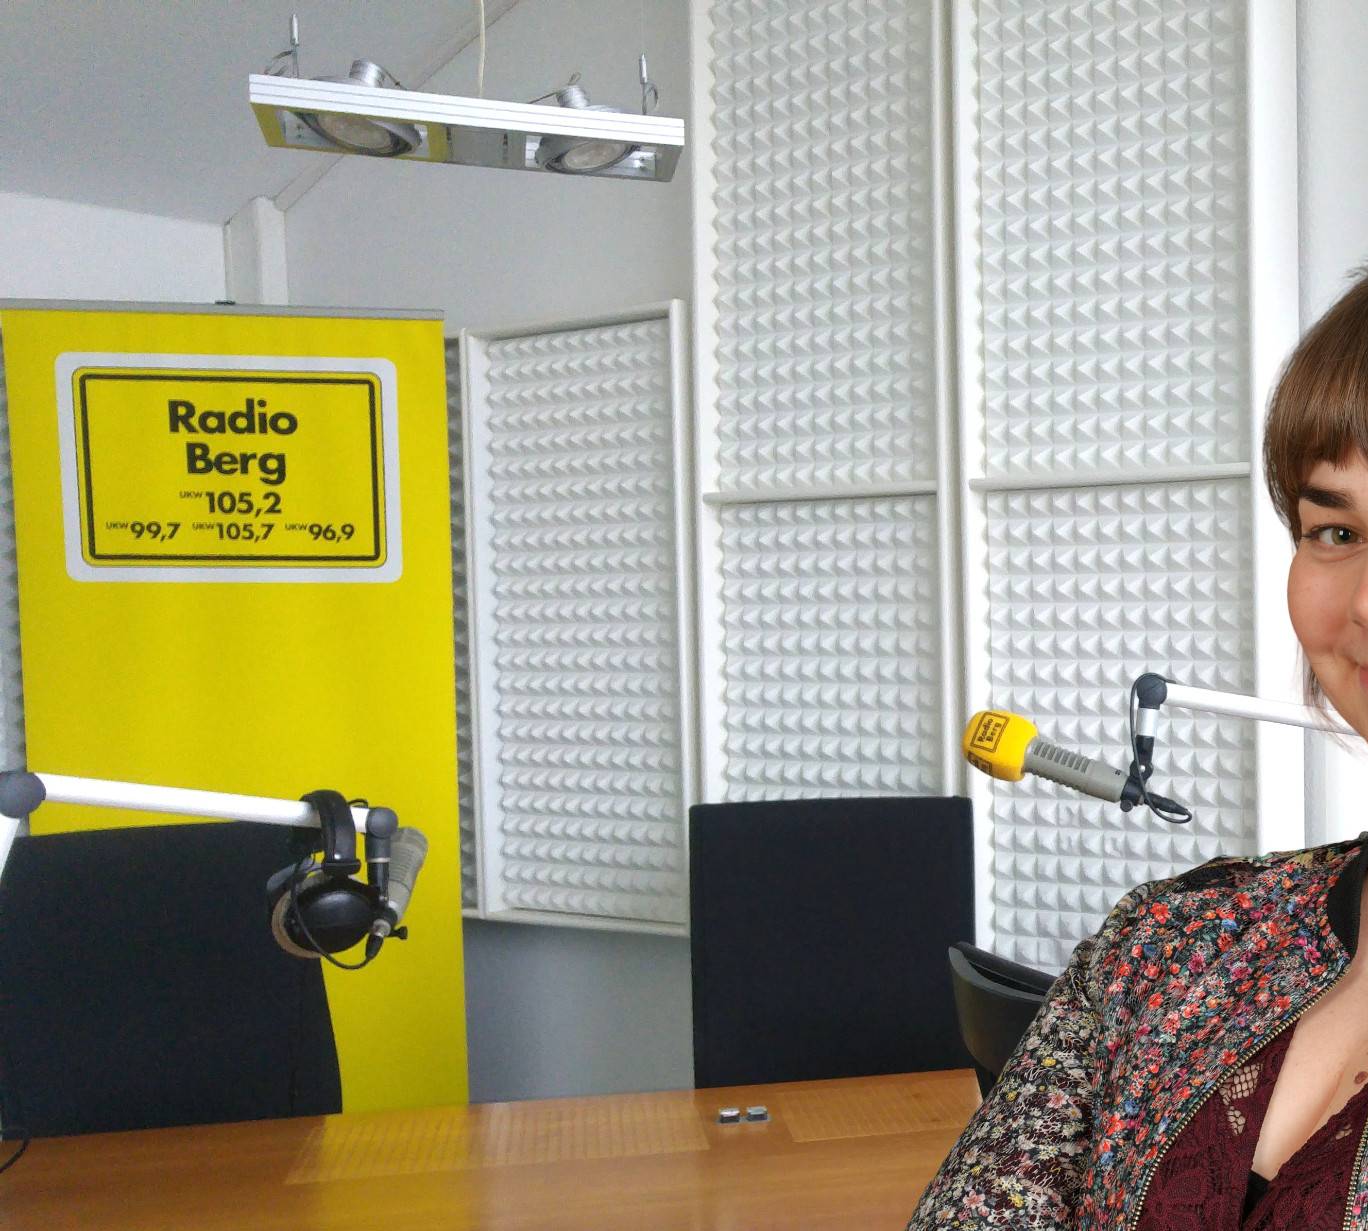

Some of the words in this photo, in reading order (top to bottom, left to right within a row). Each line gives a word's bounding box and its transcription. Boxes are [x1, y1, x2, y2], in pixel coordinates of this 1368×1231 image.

[168, 398, 298, 435] Radio
[186, 441, 286, 486] Berg
[179, 491, 203, 499] UKW
[205, 491, 282, 518] 105,2
[105, 521, 128, 530] UKW
[130, 521, 181, 543] 99,7
[215, 522, 275, 543] 105,7
[284, 522, 308, 531] UKW
[308, 523, 355, 543] 96,9
[977, 718, 994, 742] Radio
[985, 722, 1002, 742] Berg
